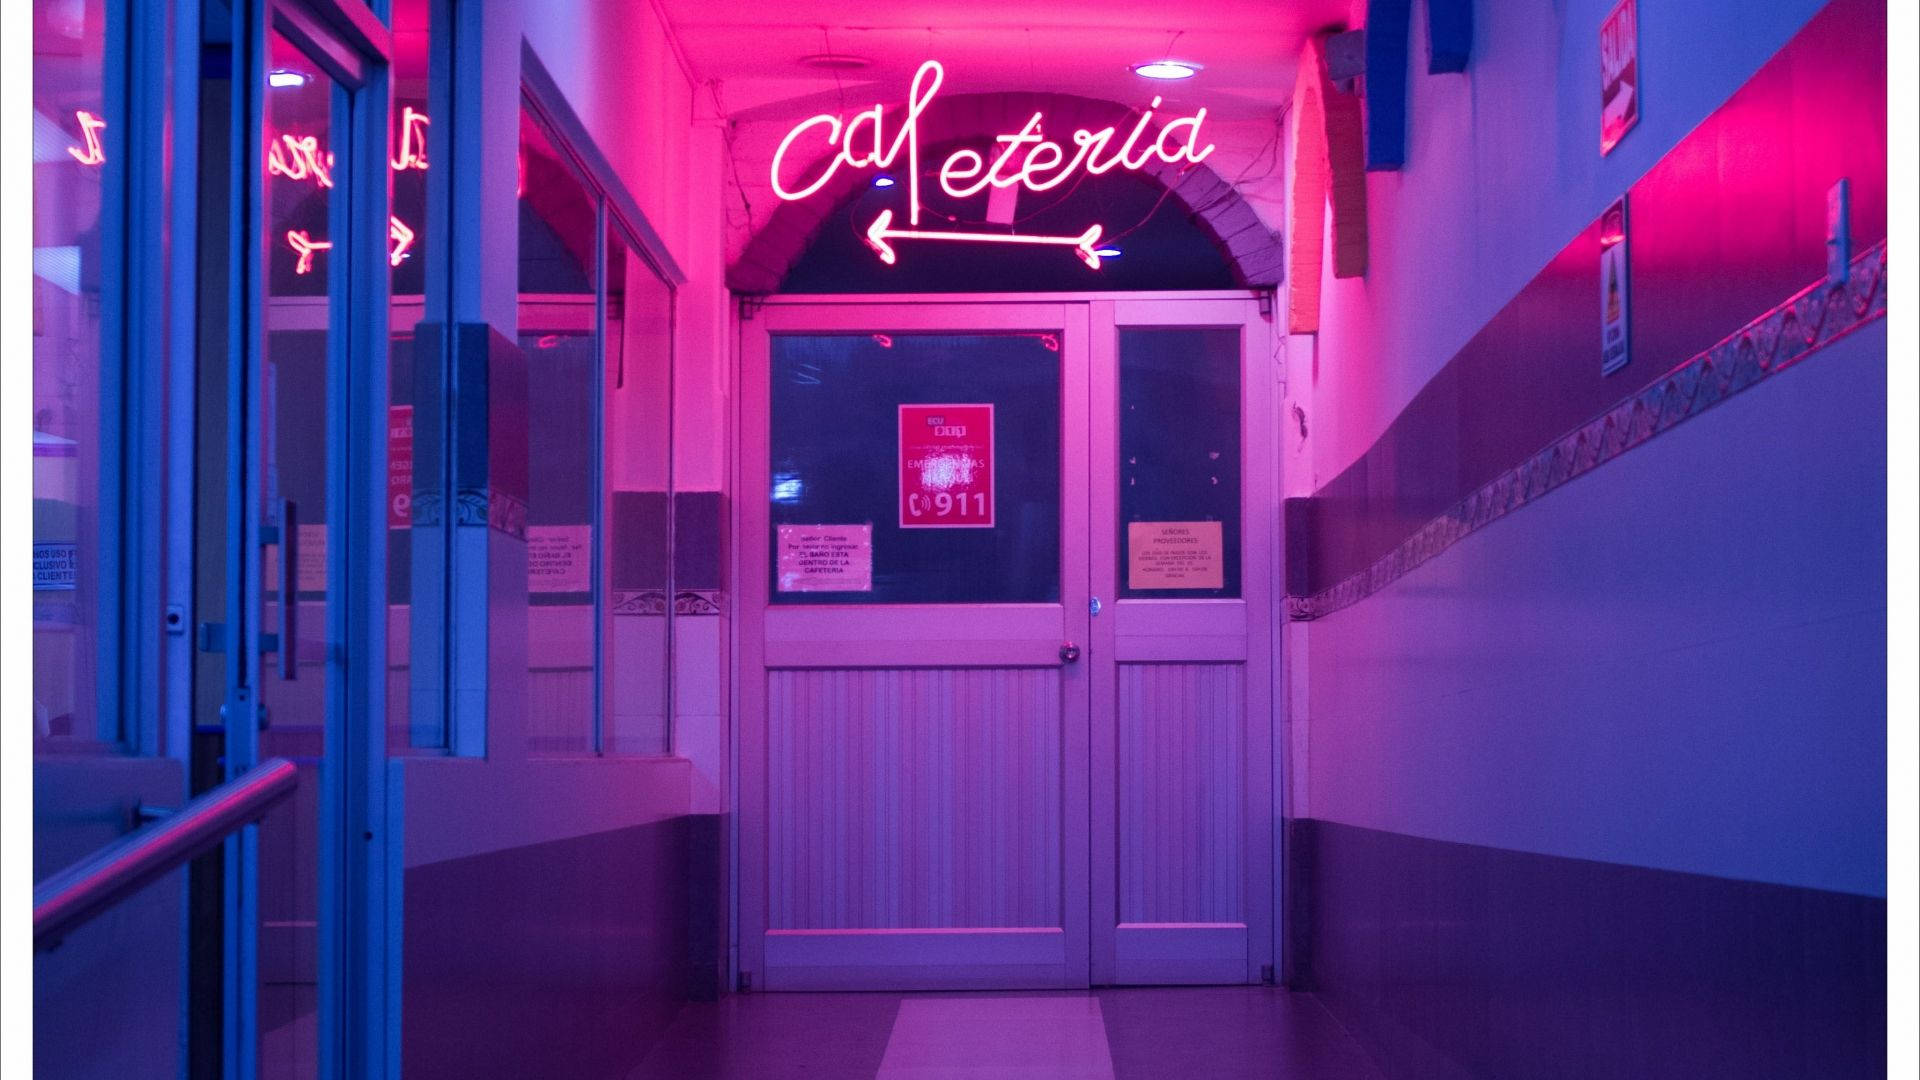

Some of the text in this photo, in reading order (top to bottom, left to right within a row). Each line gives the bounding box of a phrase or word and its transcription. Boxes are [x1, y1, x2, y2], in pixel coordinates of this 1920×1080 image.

[927, 417, 945, 425] ECU
[907, 459, 985, 469] EMERGENIAS
[934, 492, 985, 517] 911
